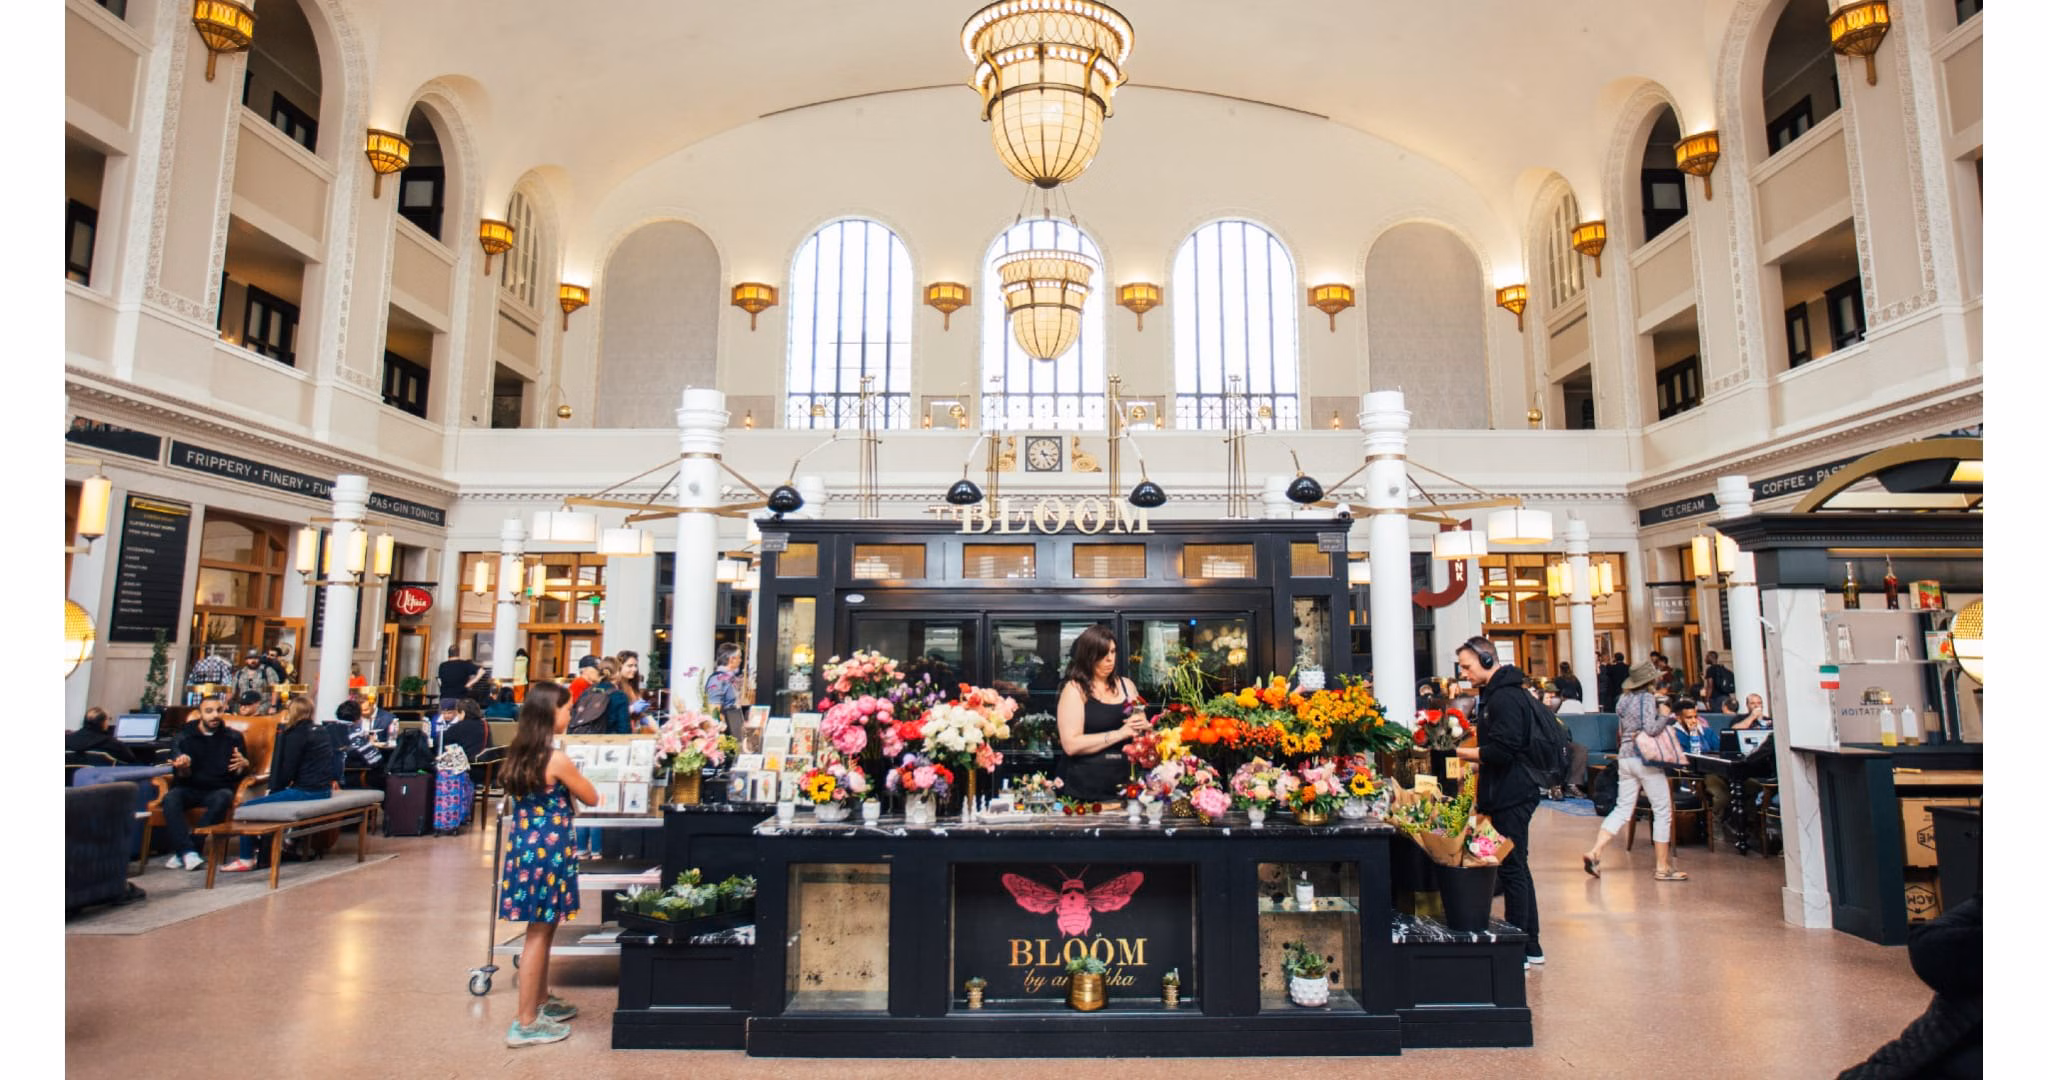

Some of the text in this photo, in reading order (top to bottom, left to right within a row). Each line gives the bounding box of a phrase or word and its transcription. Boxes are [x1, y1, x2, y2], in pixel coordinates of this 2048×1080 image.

[187, 450, 252, 476] FRIPPERY
[262, 469, 304, 489] FINERY
[1762, 475, 1806, 494] COFFEE
[393, 502, 409, 514] GIN
[410, 505, 441, 522] TONICS
[955, 497, 1155, 534] BLOOM
[1661, 499, 1706, 518] ICE CREAM
[1008, 937, 1149, 967] BLOOM
[1023, 968, 1048, 994] by
